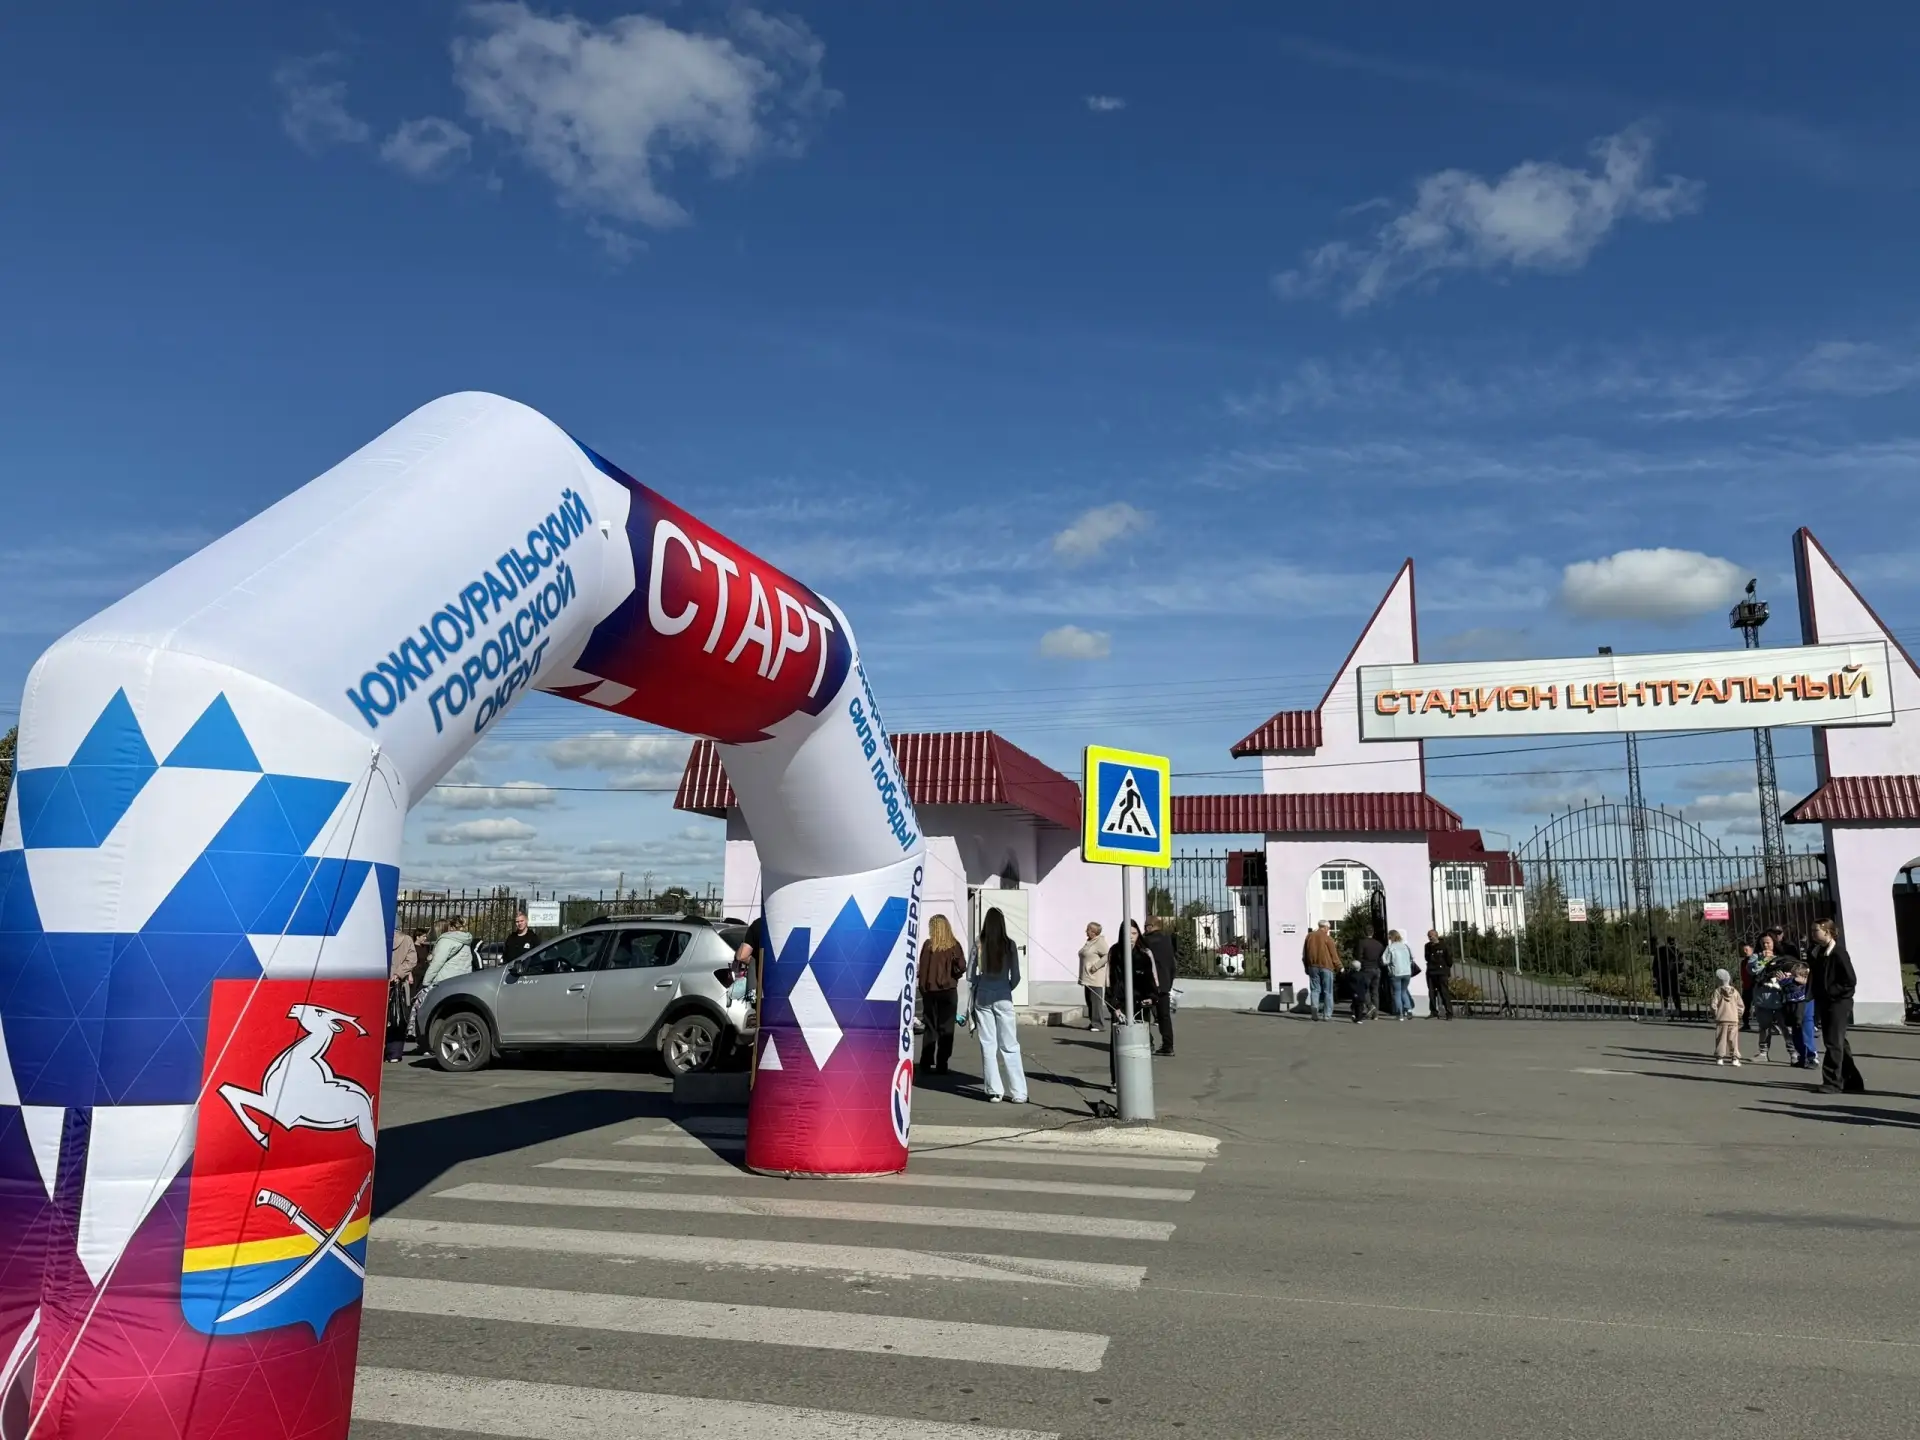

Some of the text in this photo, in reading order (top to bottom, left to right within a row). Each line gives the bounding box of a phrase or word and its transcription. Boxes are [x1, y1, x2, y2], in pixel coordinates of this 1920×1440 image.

[346, 488, 593, 729] ЮЖНОУРАЛЬСКИЙ
[428, 563, 577, 734] ГОРОДСКОЙ
[473, 636, 550, 735] ОКРУГ
[648, 519, 835, 699] СТАРТ
[1375, 664, 1874, 717] СТАДИОН ЦЕНТРАЛЬНЫЙ
[849, 697, 877, 761] сила
[902, 865, 923, 1053] ФОРЭНЕРГО
